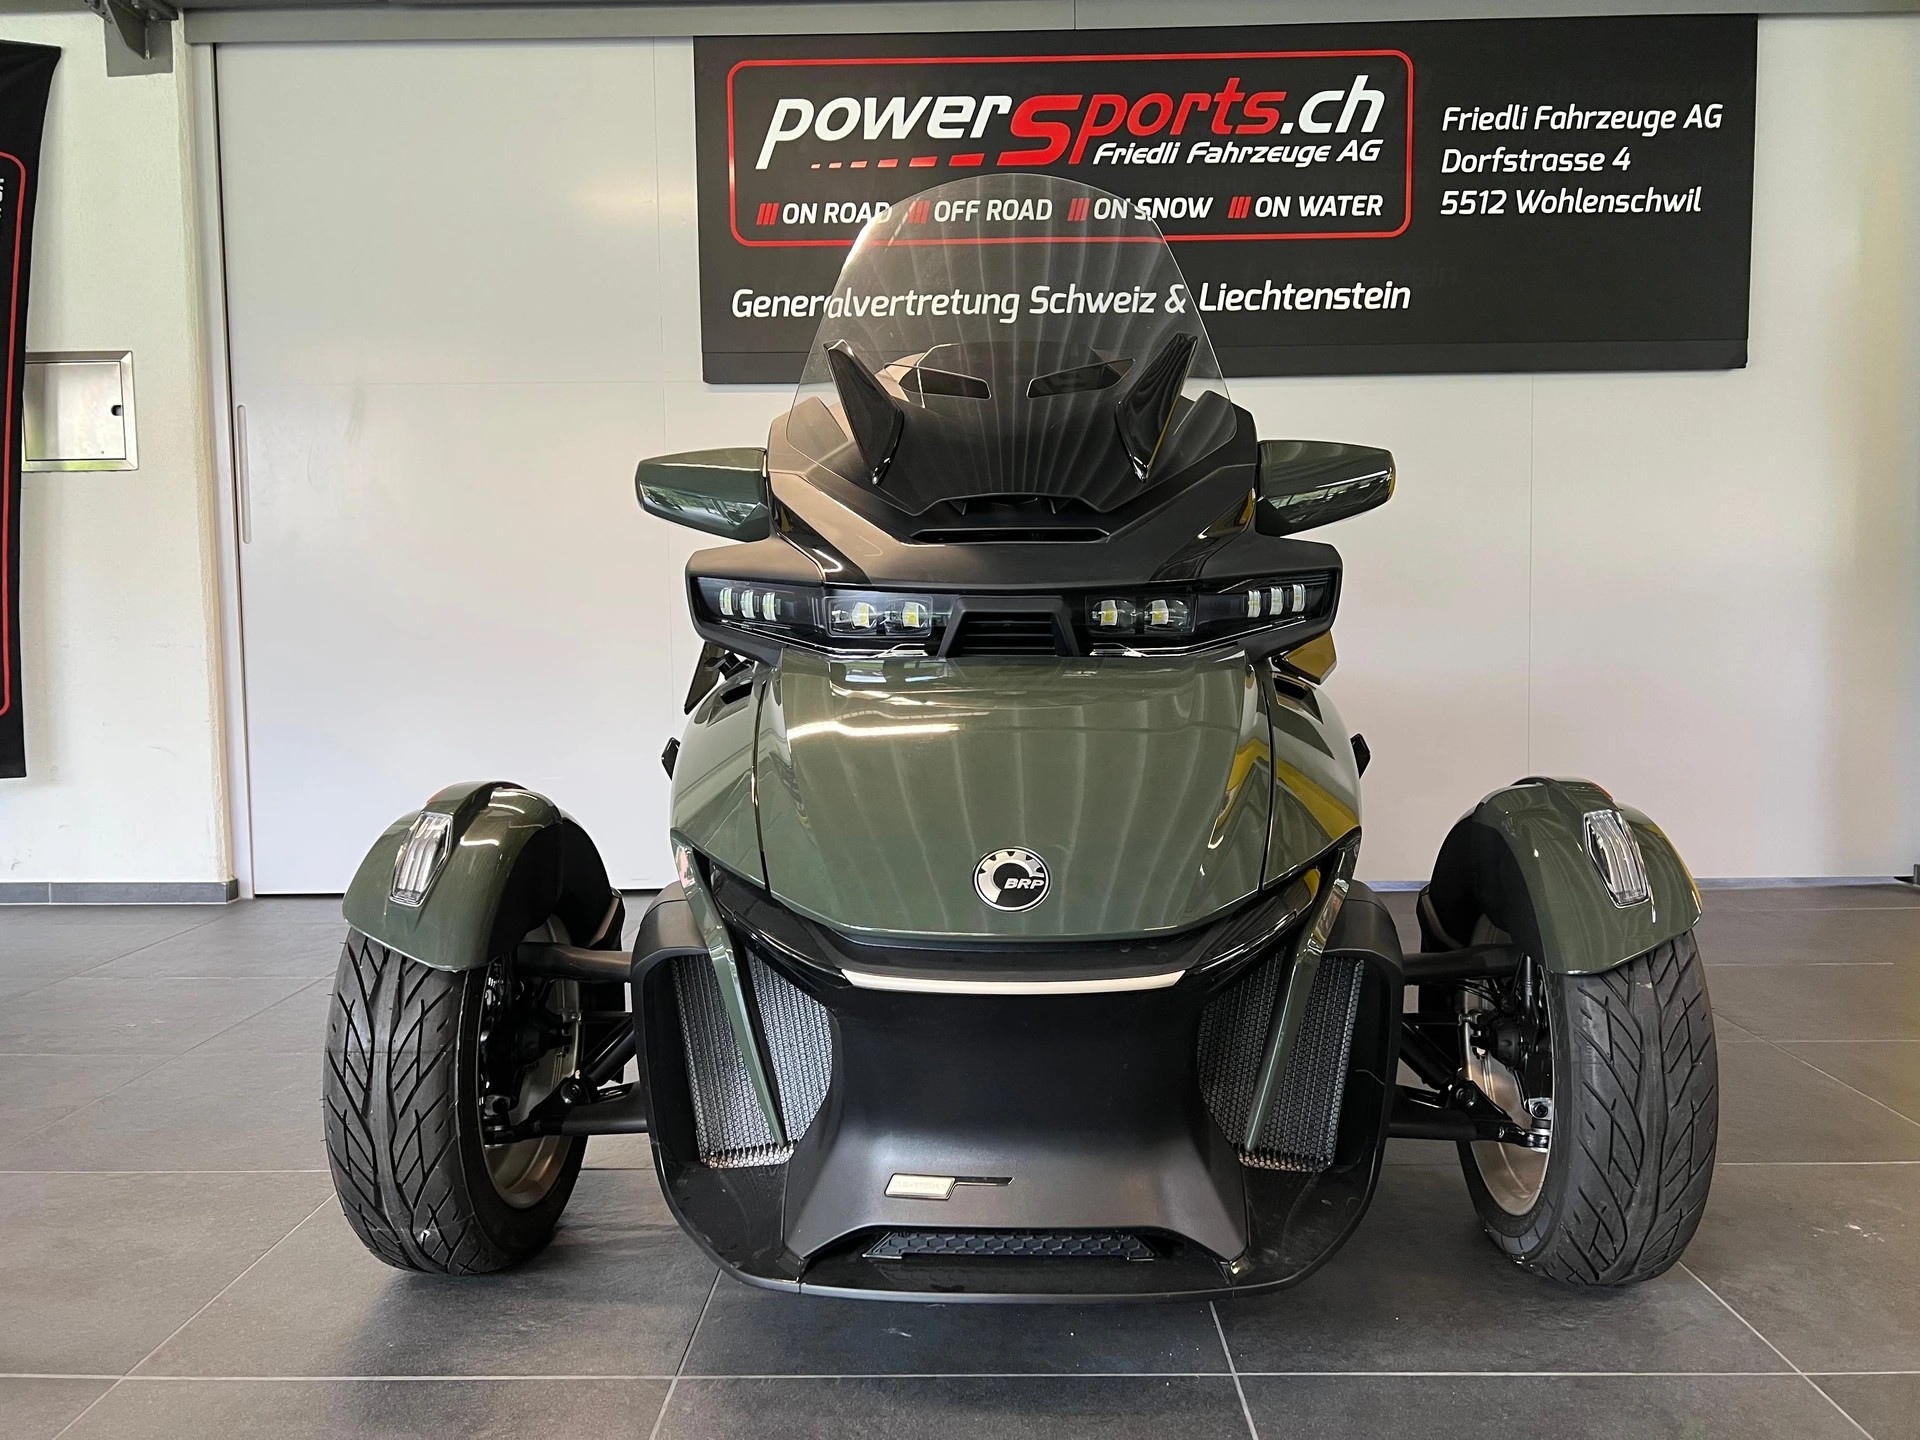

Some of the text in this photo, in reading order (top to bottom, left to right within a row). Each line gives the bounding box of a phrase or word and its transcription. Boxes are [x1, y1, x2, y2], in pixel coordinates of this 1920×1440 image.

[1441, 103, 1724, 137] Friedli Fahrzeuge AG
[1092, 139, 1384, 168] Friedli Fahrzeuge AG
[1441, 146, 1631, 173] Dorfstrasse 4
[782, 201, 893, 225] ON ROAD
[933, 198, 1053, 223] OFF ROAD
[1093, 196, 1214, 221] ON SNOW
[1254, 194, 1384, 218] ON WATER
[1440, 186, 1702, 215] 5512 Wohlenschwil
[731, 279, 1411, 325] Generalvertretung Schweiz & Liechtenstein
[1003, 877, 1045, 890] BRP
